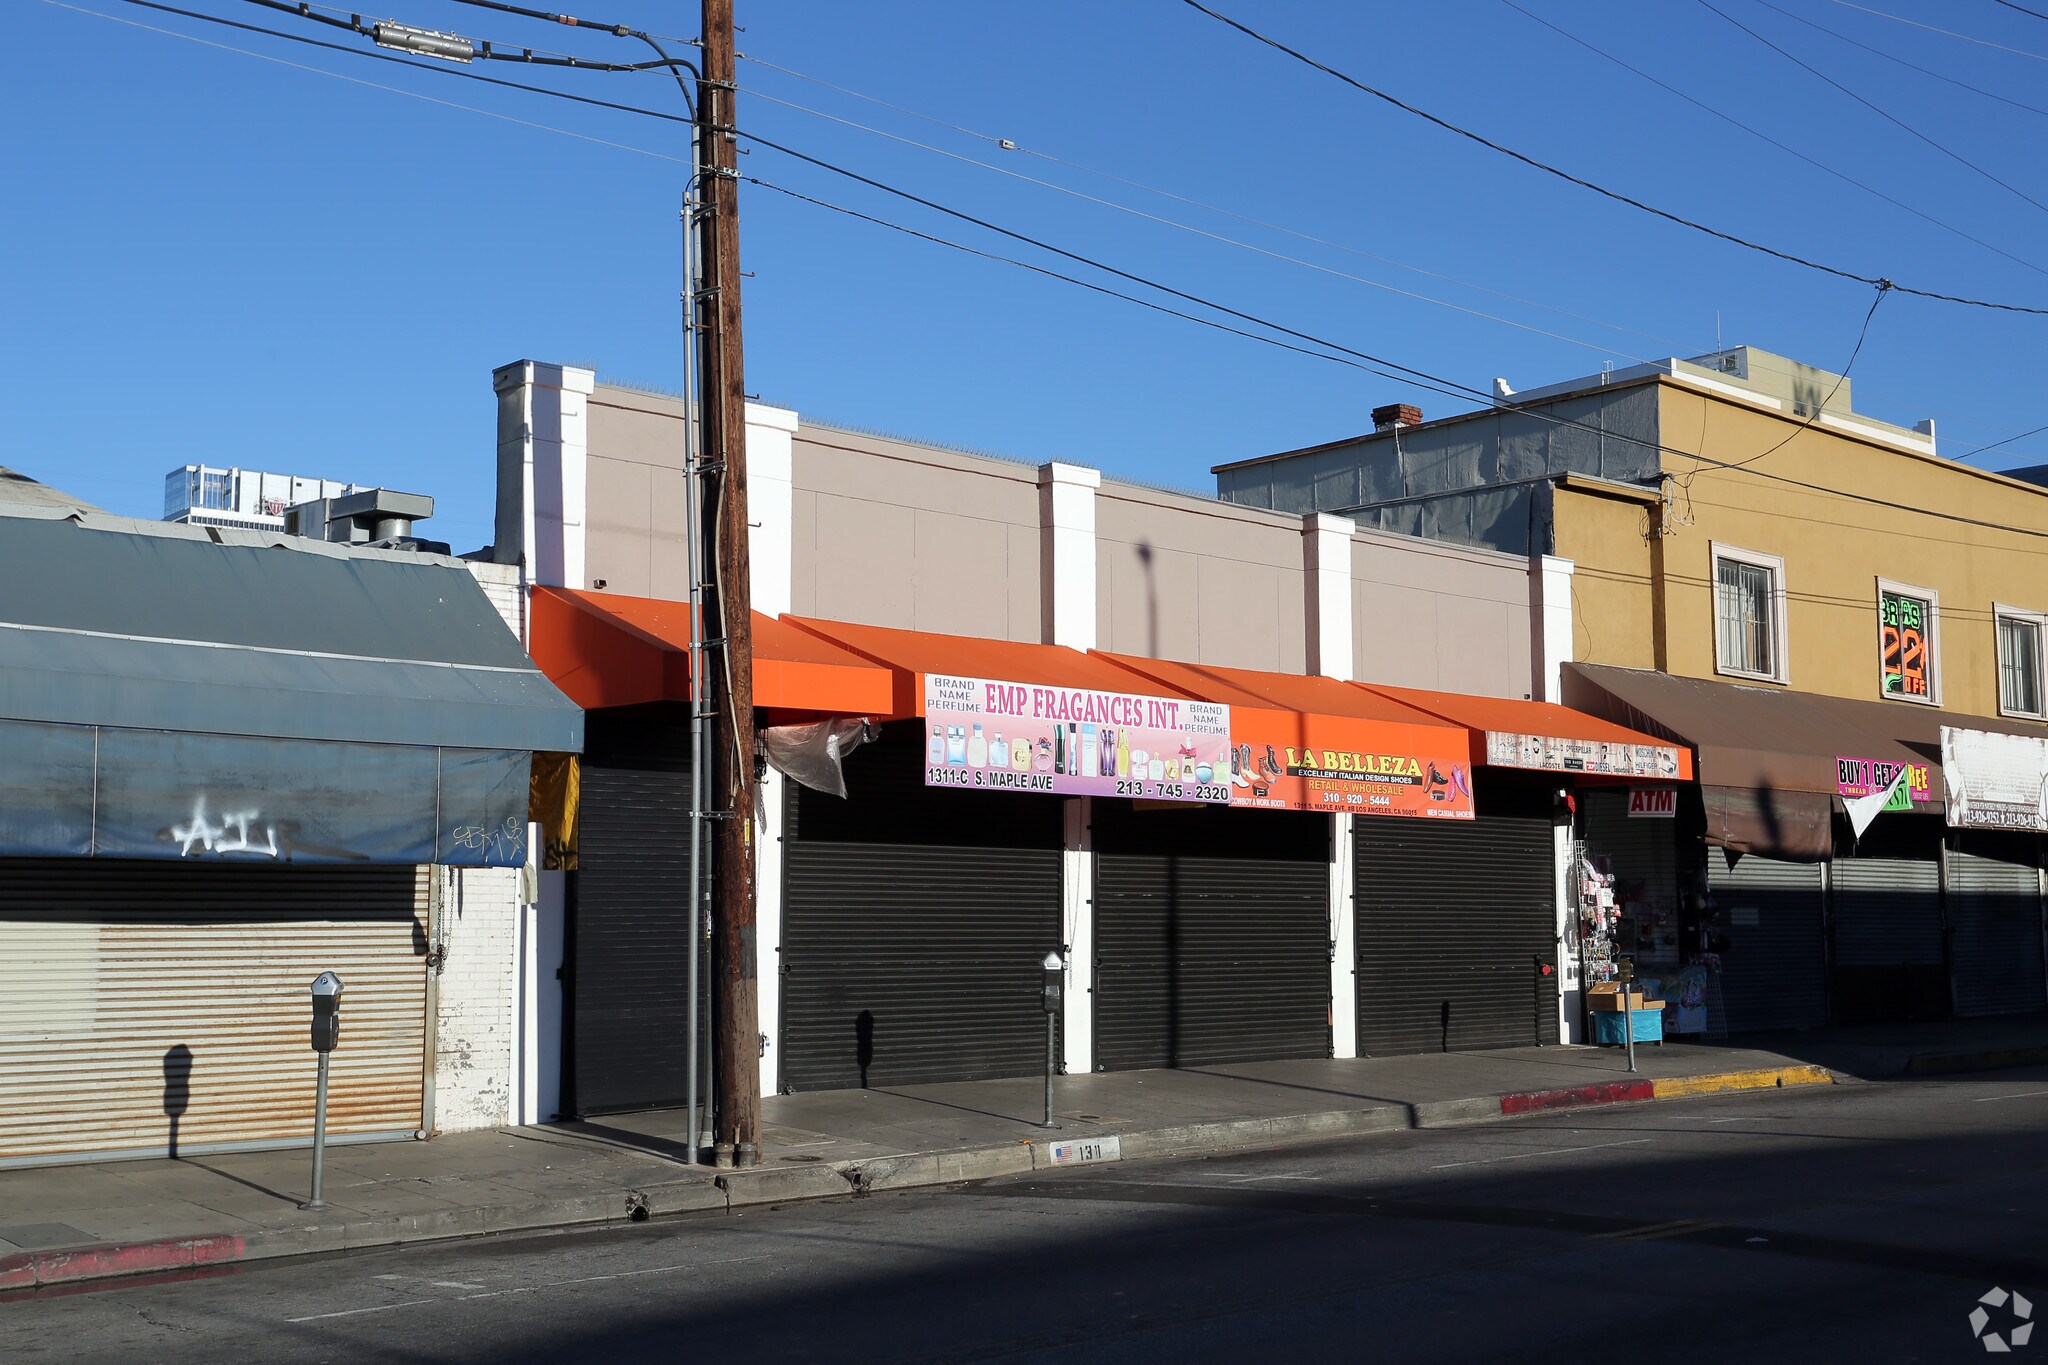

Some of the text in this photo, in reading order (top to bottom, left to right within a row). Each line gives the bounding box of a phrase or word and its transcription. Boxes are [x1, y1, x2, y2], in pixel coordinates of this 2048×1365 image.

[1883, 598, 1920, 629] BRAS
[934, 677, 975, 691] BRAND
[939, 689, 971, 702] NAME
[927, 699, 981, 713] PERFUME
[985, 683, 1184, 731] EMP FRAGANCES INT.
[1189, 703, 1222, 716] BRAND
[1193, 714, 1219, 725] NAME
[1184, 723, 1228, 736] PERFUME
[1285, 747, 1423, 777] LA BELLEZA
[1539, 762, 1561, 770] LACOSTE
[1595, 762, 1611, 772] DIESEL
[1635, 762, 1658, 770] HILFIGER
[928, 767, 1053, 790] 1311-C S. MAPLE AVE
[1298, 769, 1412, 784] EXCELLENT ITALIAN DESIGN SHOES
[1838, 759, 1861, 785] BUY
[1862, 761, 1869, 786] 1
[1874, 763, 1893, 787] GET
[1907, 764, 1928, 791] REE
[1116, 780, 1143, 795] 213
[1156, 783, 1183, 797] 745
[1195, 786, 1228, 800] 2320
[1308, 779, 1403, 796] RETAIL & WHOLESALE
[1256, 798, 1270, 806] WORK
[1270, 799, 1286, 807] BOOTS
[1324, 792, 1340, 803] 310
[1347, 794, 1362, 804] 920
[1369, 796, 1390, 806] 5444
[1631, 790, 1673, 812] ATM
[1402, 808, 1418, 816] 90015
[1427, 809, 1473, 819] MEN CASUAL SHOES
[1079, 1145, 1102, 1161] 1311
